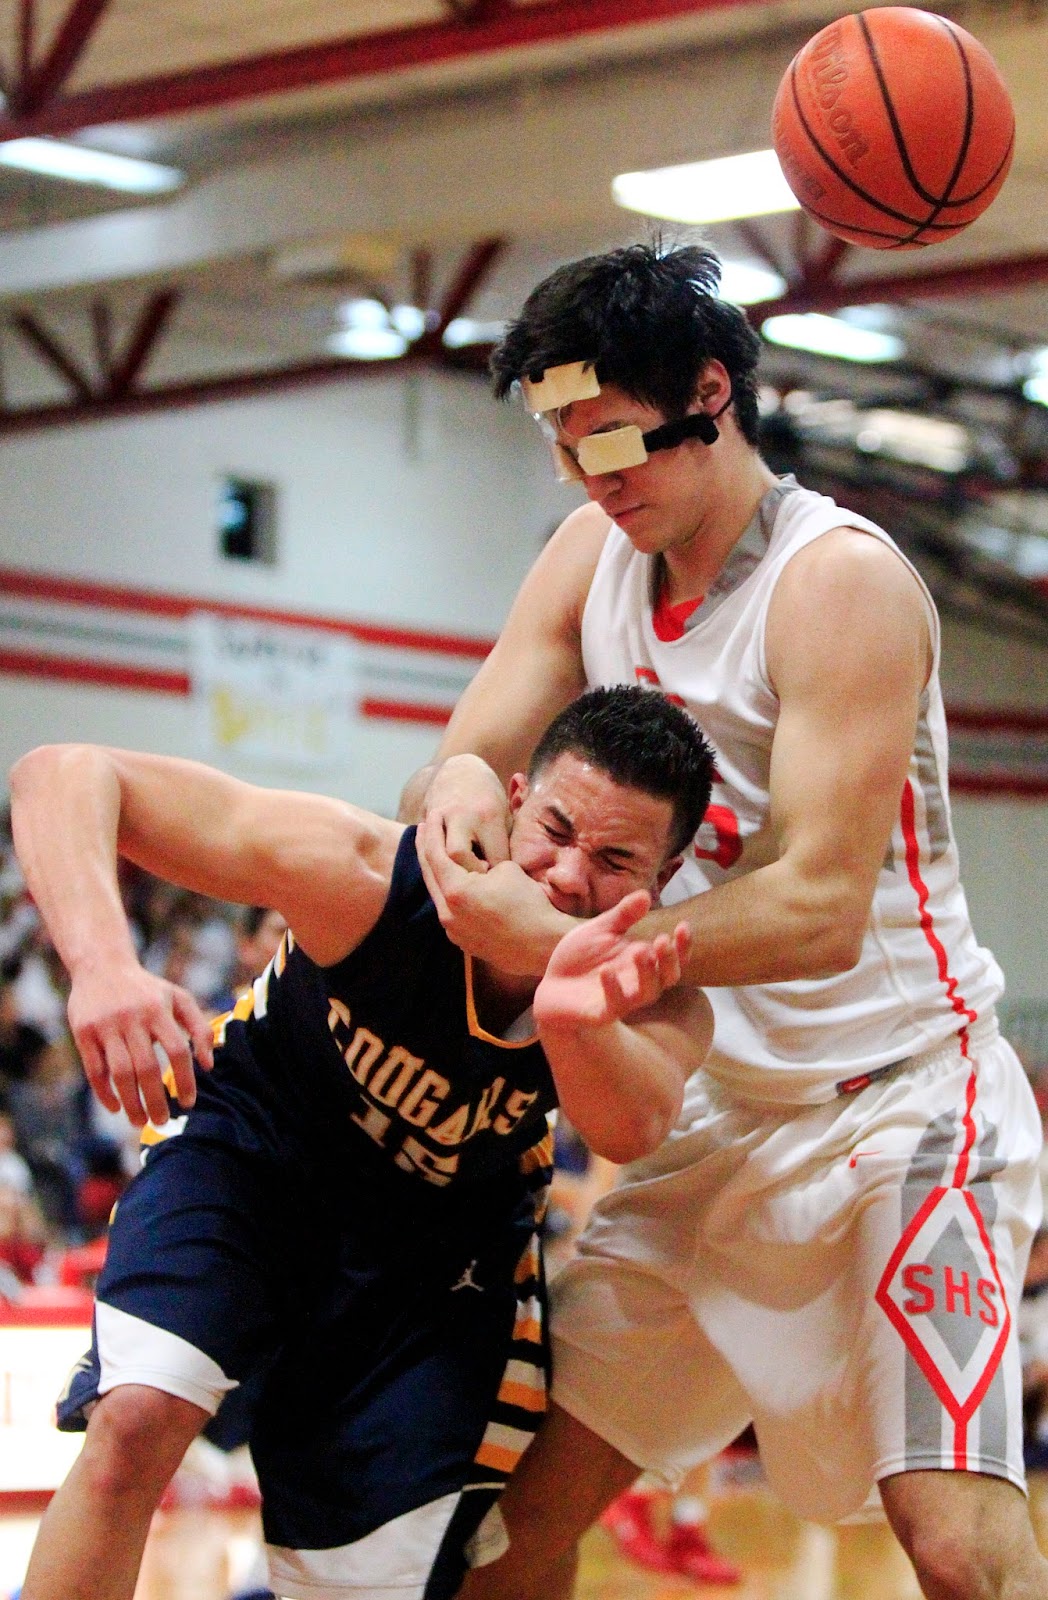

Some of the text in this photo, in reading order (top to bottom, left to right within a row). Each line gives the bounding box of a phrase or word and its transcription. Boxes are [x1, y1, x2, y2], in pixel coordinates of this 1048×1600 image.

[810, 25, 870, 170] Wilson
[350, 1093, 461, 1188] 15
[902, 1264, 999, 1328] SHS
